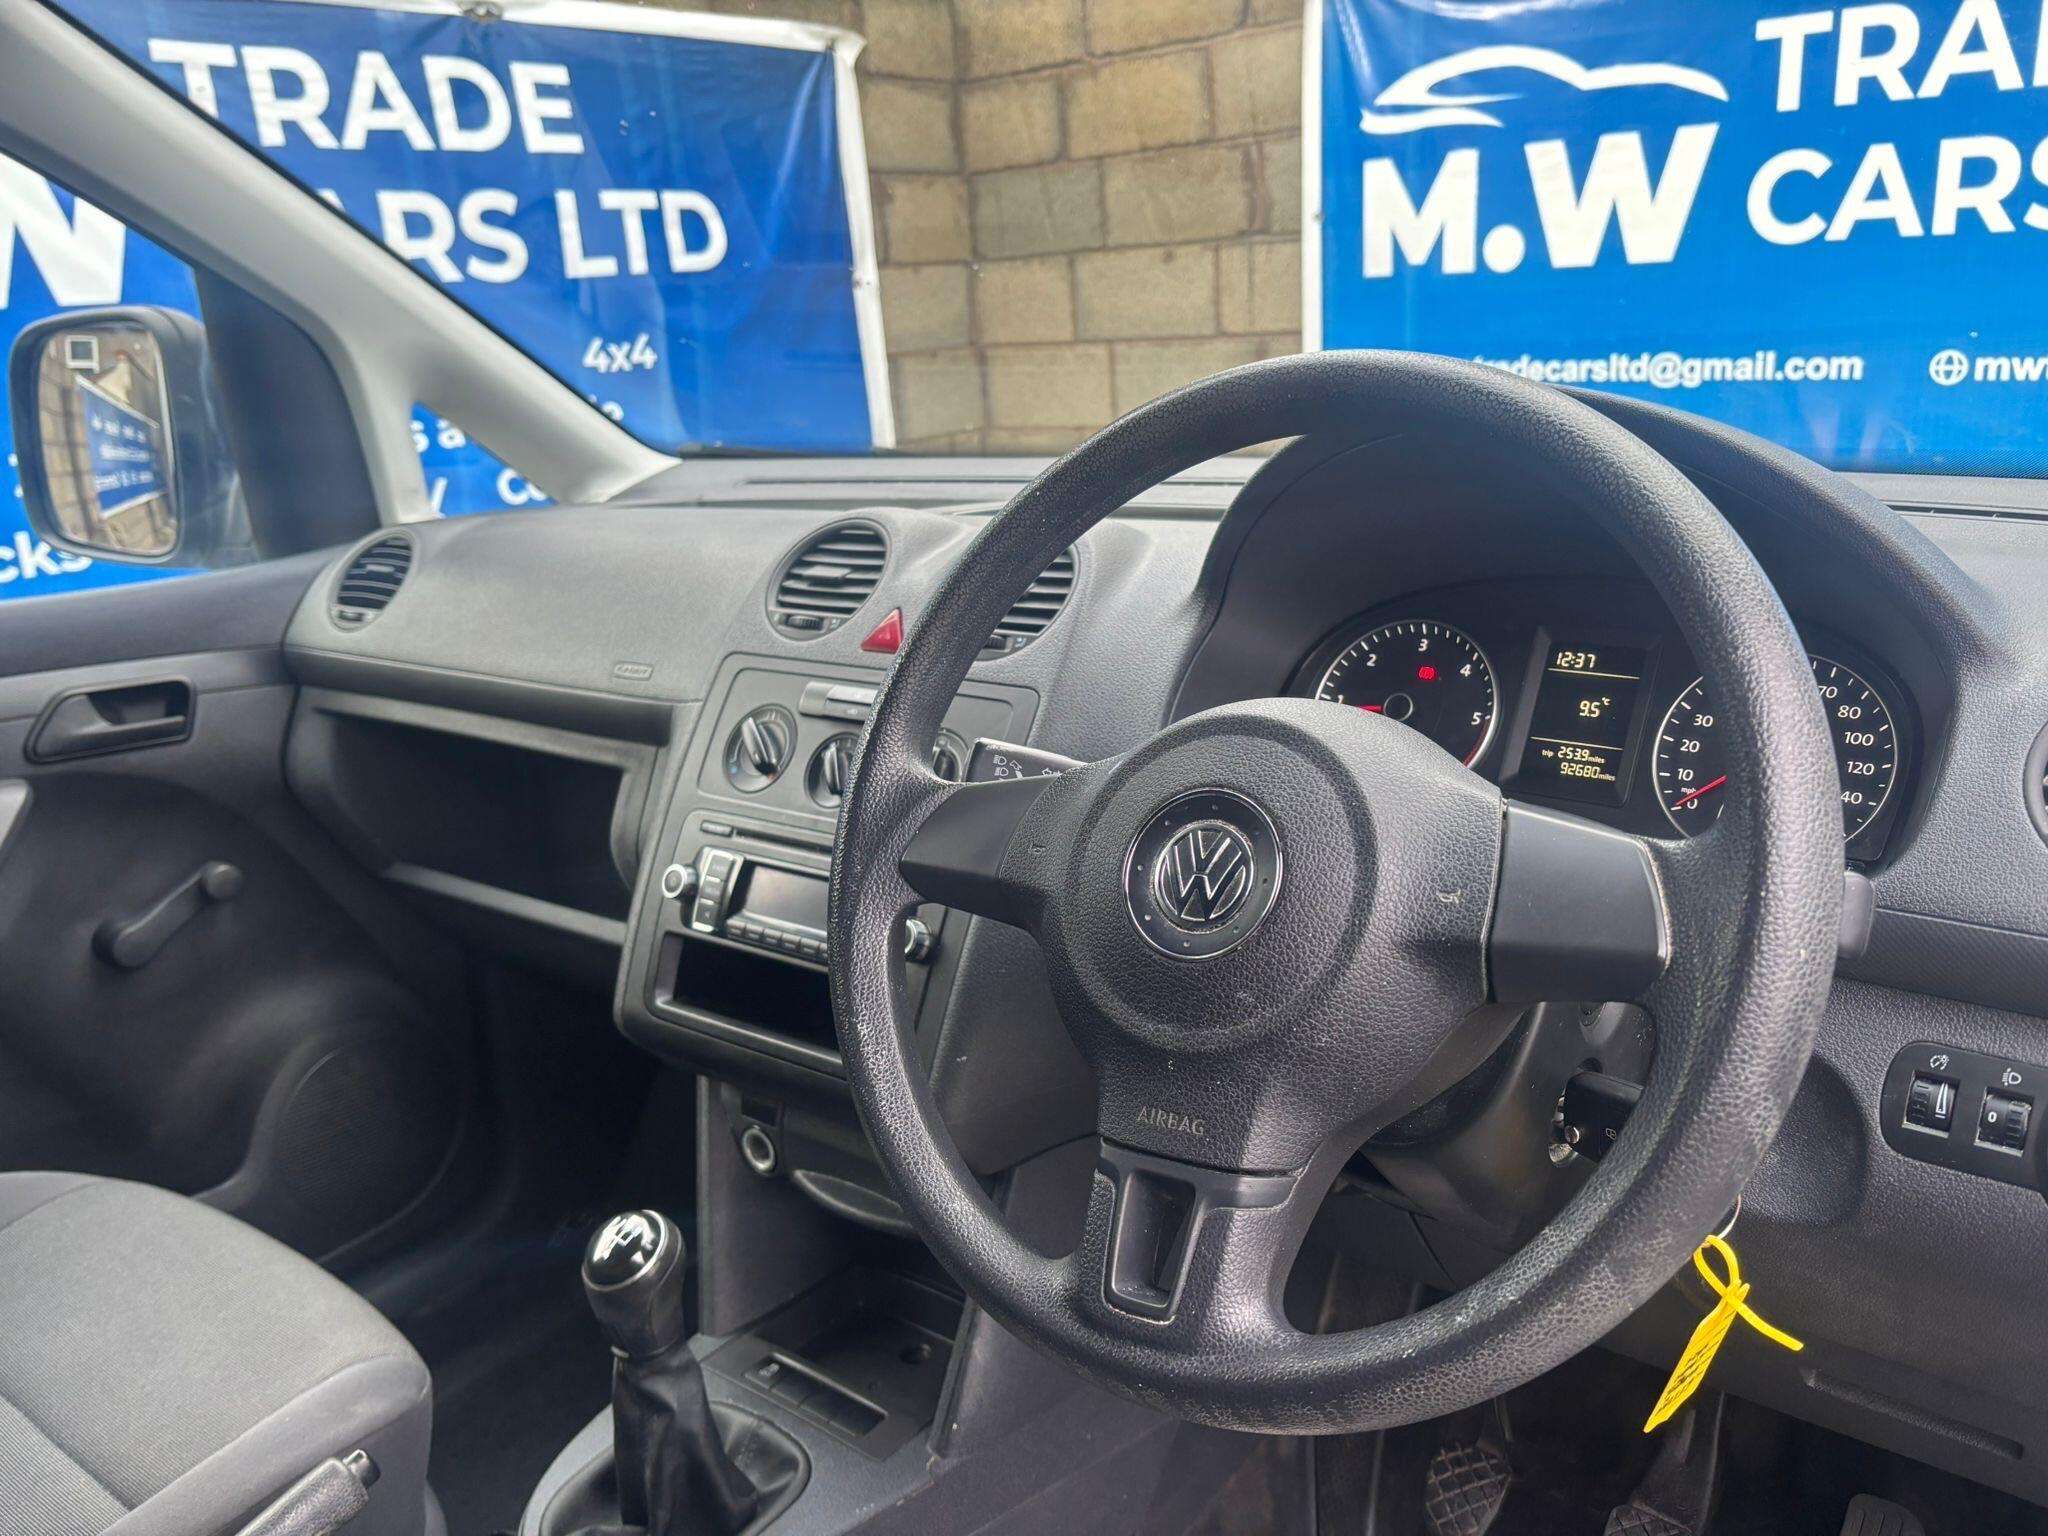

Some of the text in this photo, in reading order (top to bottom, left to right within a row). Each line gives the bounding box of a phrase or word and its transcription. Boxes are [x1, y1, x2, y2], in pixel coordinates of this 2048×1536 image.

[1753, 0, 2048, 113] TRA
[147, 37, 585, 155] TRADE
[1361, 122, 1721, 279] M.W
[555, 190, 728, 280] LTD
[582, 332, 658, 374] 4x4
[1418, 638, 1429, 652] 3
[1366, 653, 1378, 667] 2
[1556, 651, 1596, 669] 12:37
[1459, 663, 1472, 677] 4
[1471, 711, 1483, 725] 5
[1837, 705, 1862, 719] 80
[1693, 713, 1714, 728] 30
[1680, 739, 1700, 753] 20
[1844, 731, 1874, 747] 100
[1541, 748, 1555, 760] trip
[1677, 768, 1694, 782] 10
[1846, 761, 1875, 776] 120
[1840, 790, 1863, 805] 40
[1137, 1105, 1205, 1136] AIRBAG
